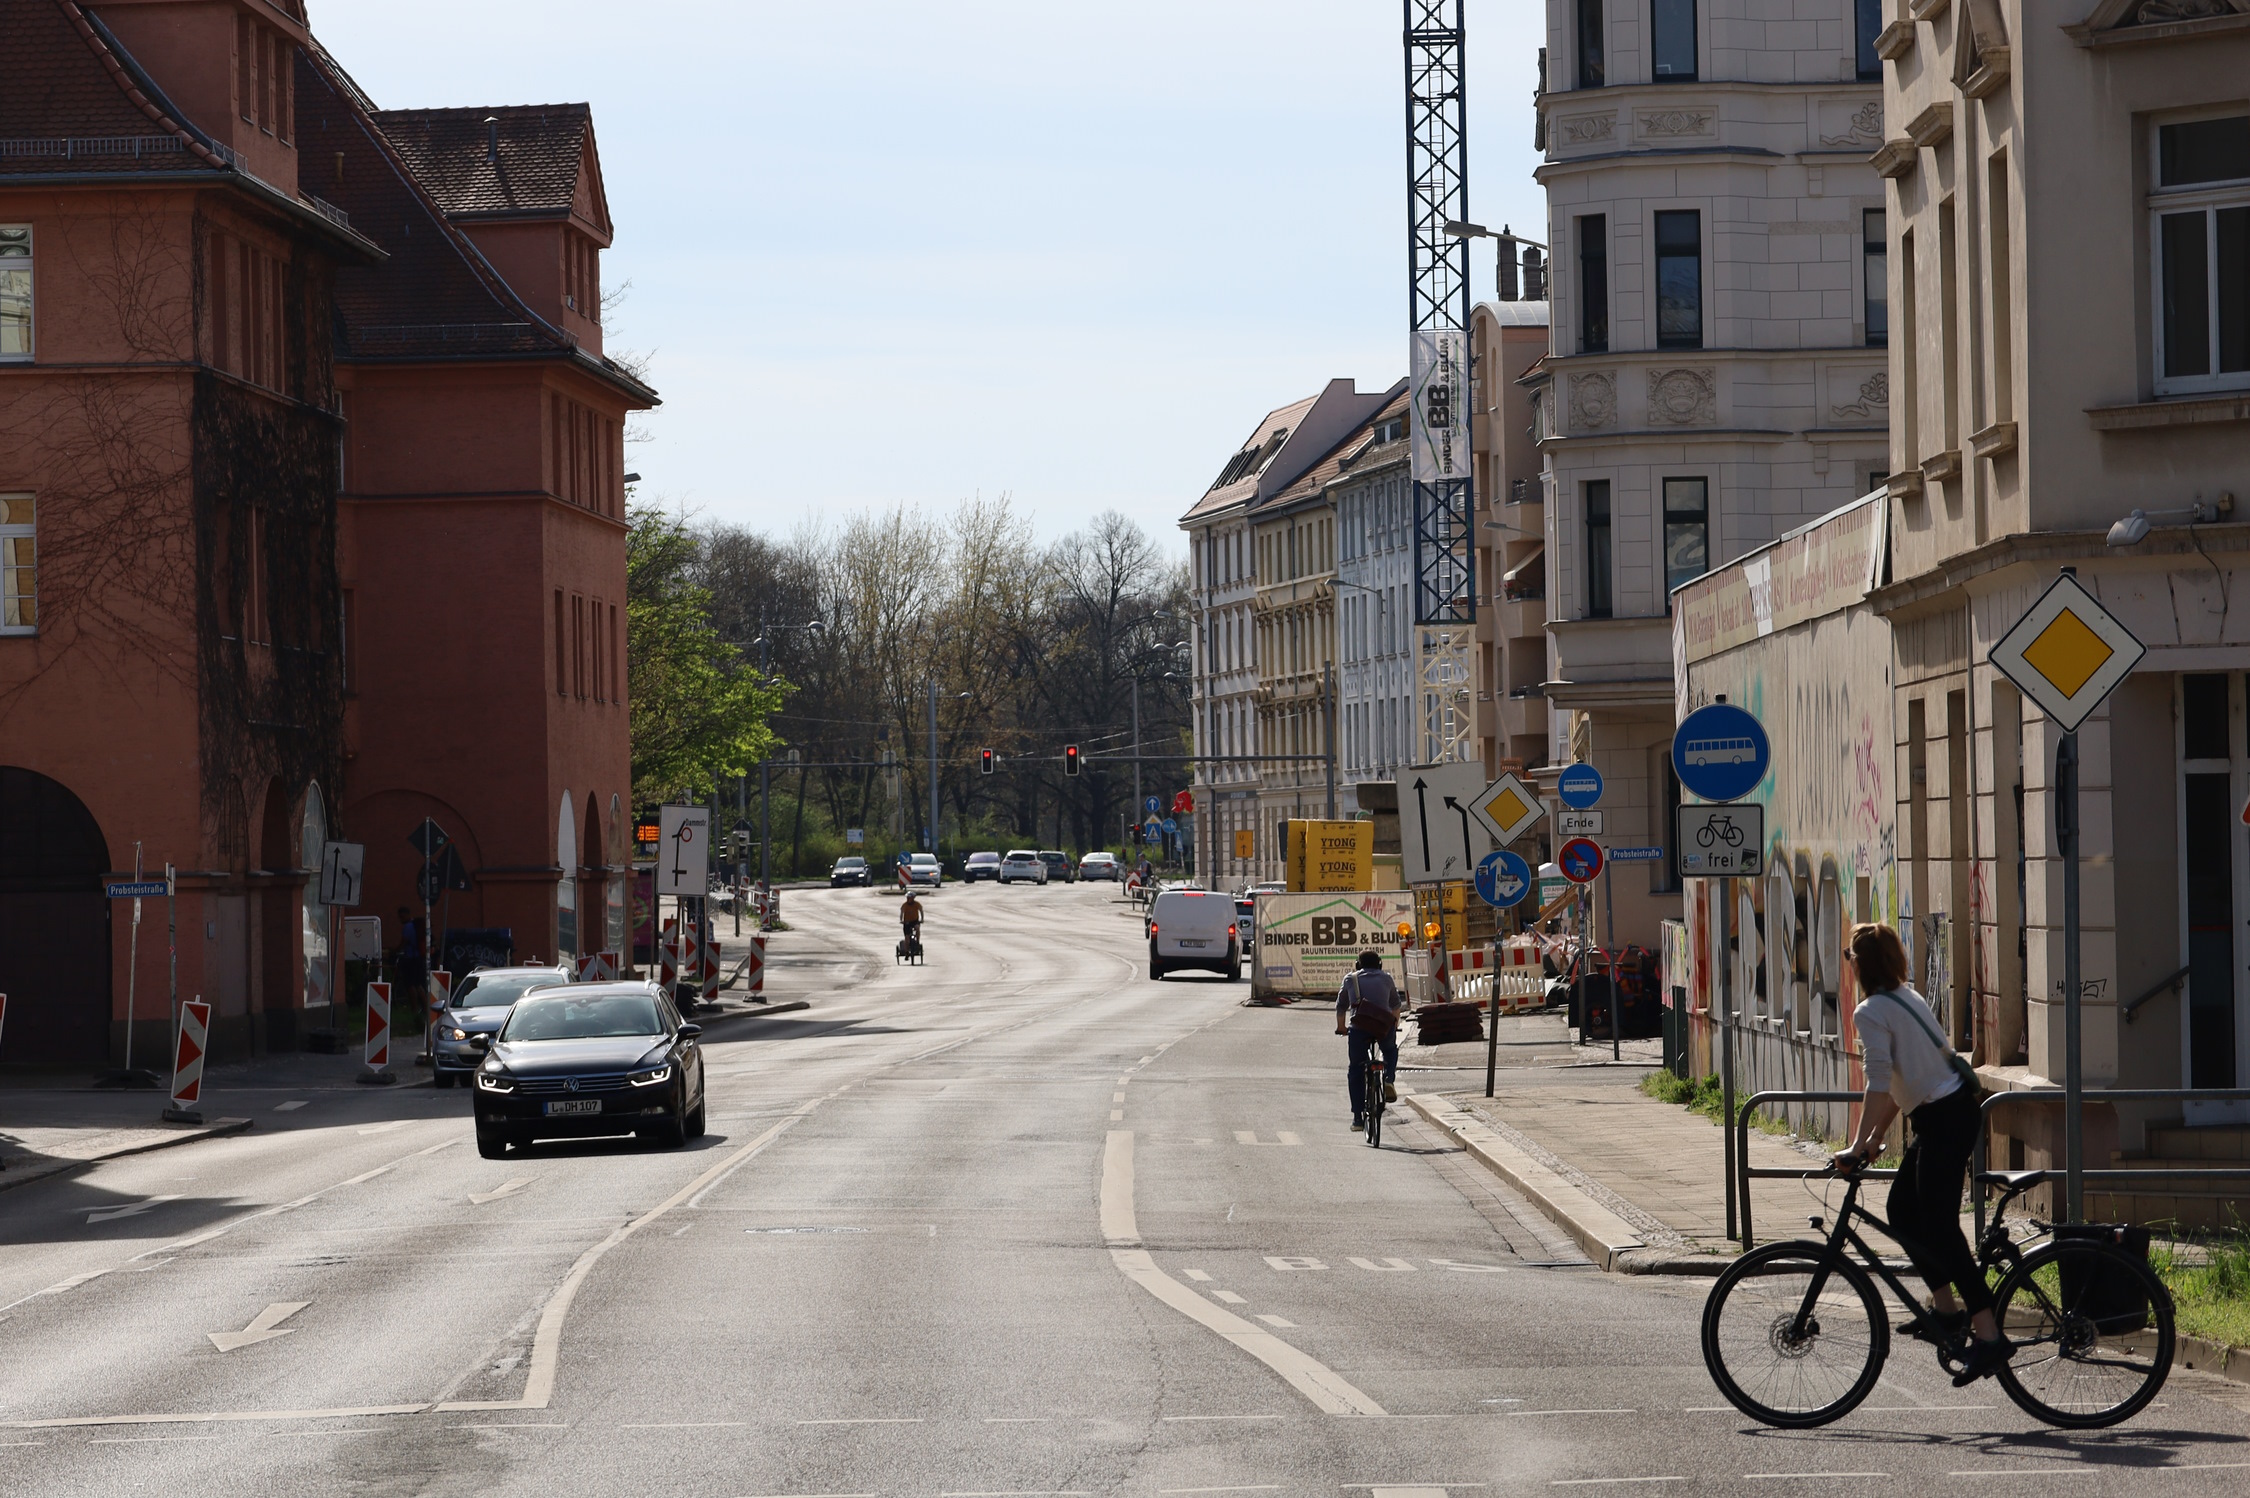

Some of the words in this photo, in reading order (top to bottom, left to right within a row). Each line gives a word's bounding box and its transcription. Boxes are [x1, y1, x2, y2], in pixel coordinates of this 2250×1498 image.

[1440, 338, 1449, 373] BLUM
[1428, 384, 1450, 428] BB
[1442, 430, 1453, 474] BINDER
[1566, 818, 1594, 828] Ende
[1320, 838, 1356, 848] YTONG
[1613, 850, 1660, 858] Probsteistraße
[1708, 852, 1734, 868] frei
[1320, 862, 1356, 872] YTONG
[110, 884, 164, 894] Probsteistraße
[1264, 932, 1309, 946] BINDER
[1312, 916, 1358, 946] BB
[1360, 933, 1369, 944] &
[552, 1103, 558, 1112] L
[564, 1102, 577, 1112] DH
[580, 1101, 597, 1111] 107
